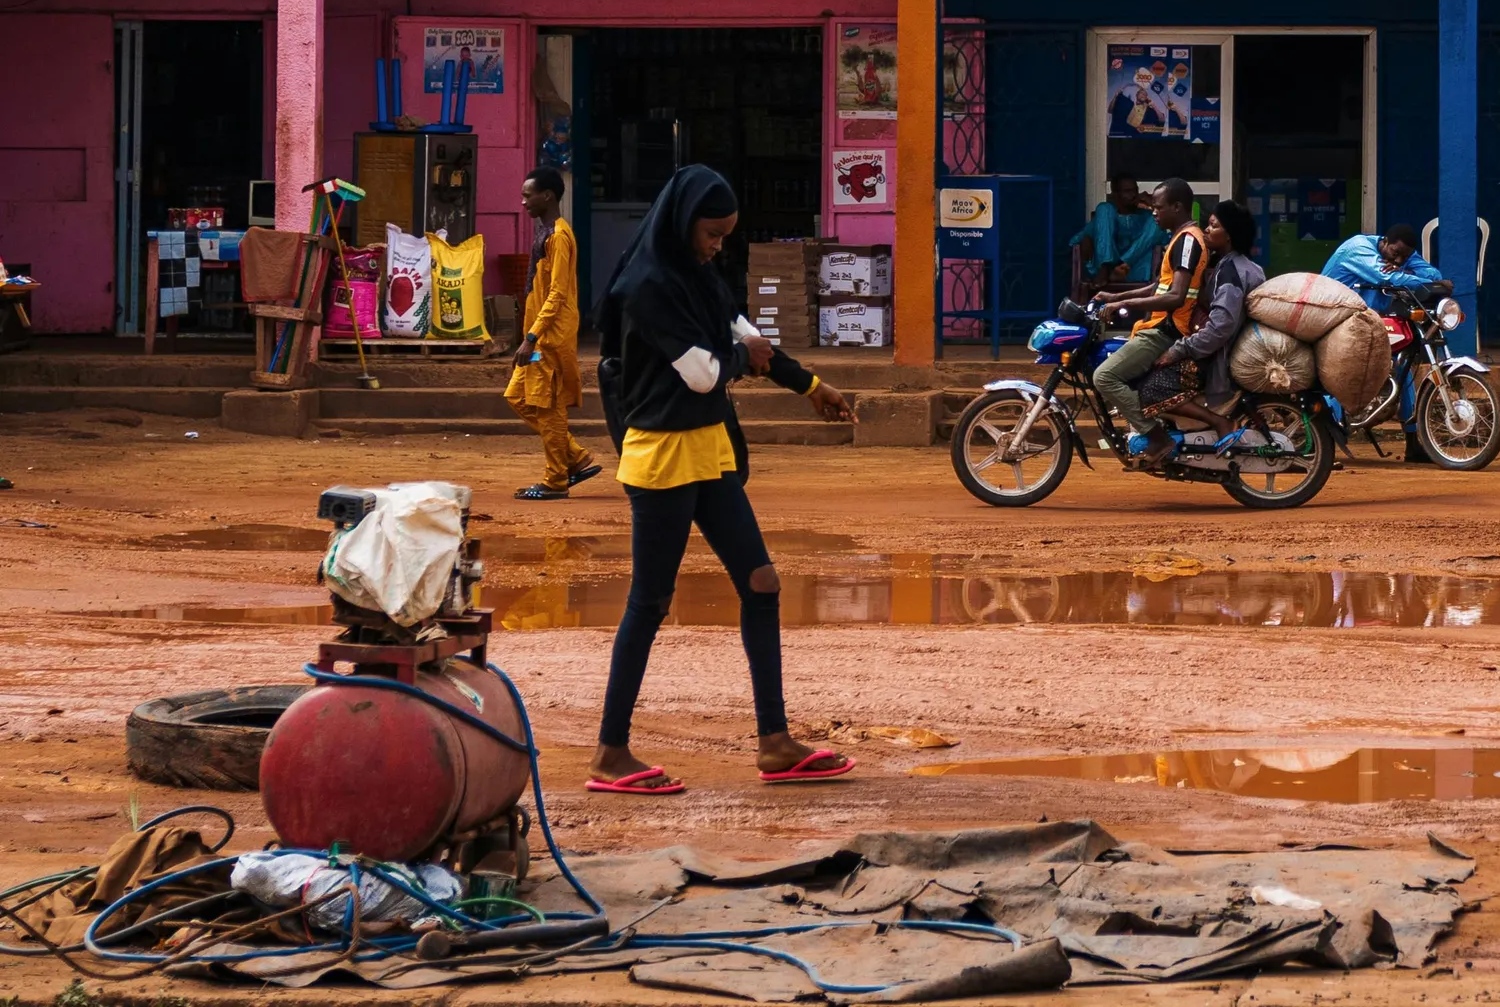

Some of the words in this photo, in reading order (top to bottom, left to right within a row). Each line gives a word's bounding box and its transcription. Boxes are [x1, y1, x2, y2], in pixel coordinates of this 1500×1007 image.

[840, 154, 862, 165] Vache
[863, 153, 874, 161] qui
[874, 154, 883, 162] rit
[951, 199, 973, 207] Moov
[951, 206, 974, 214] Africa
[949, 230, 984, 238] Disponible
[436, 277, 465, 288] AKADI
[838, 304, 864, 314] Kentcafe
